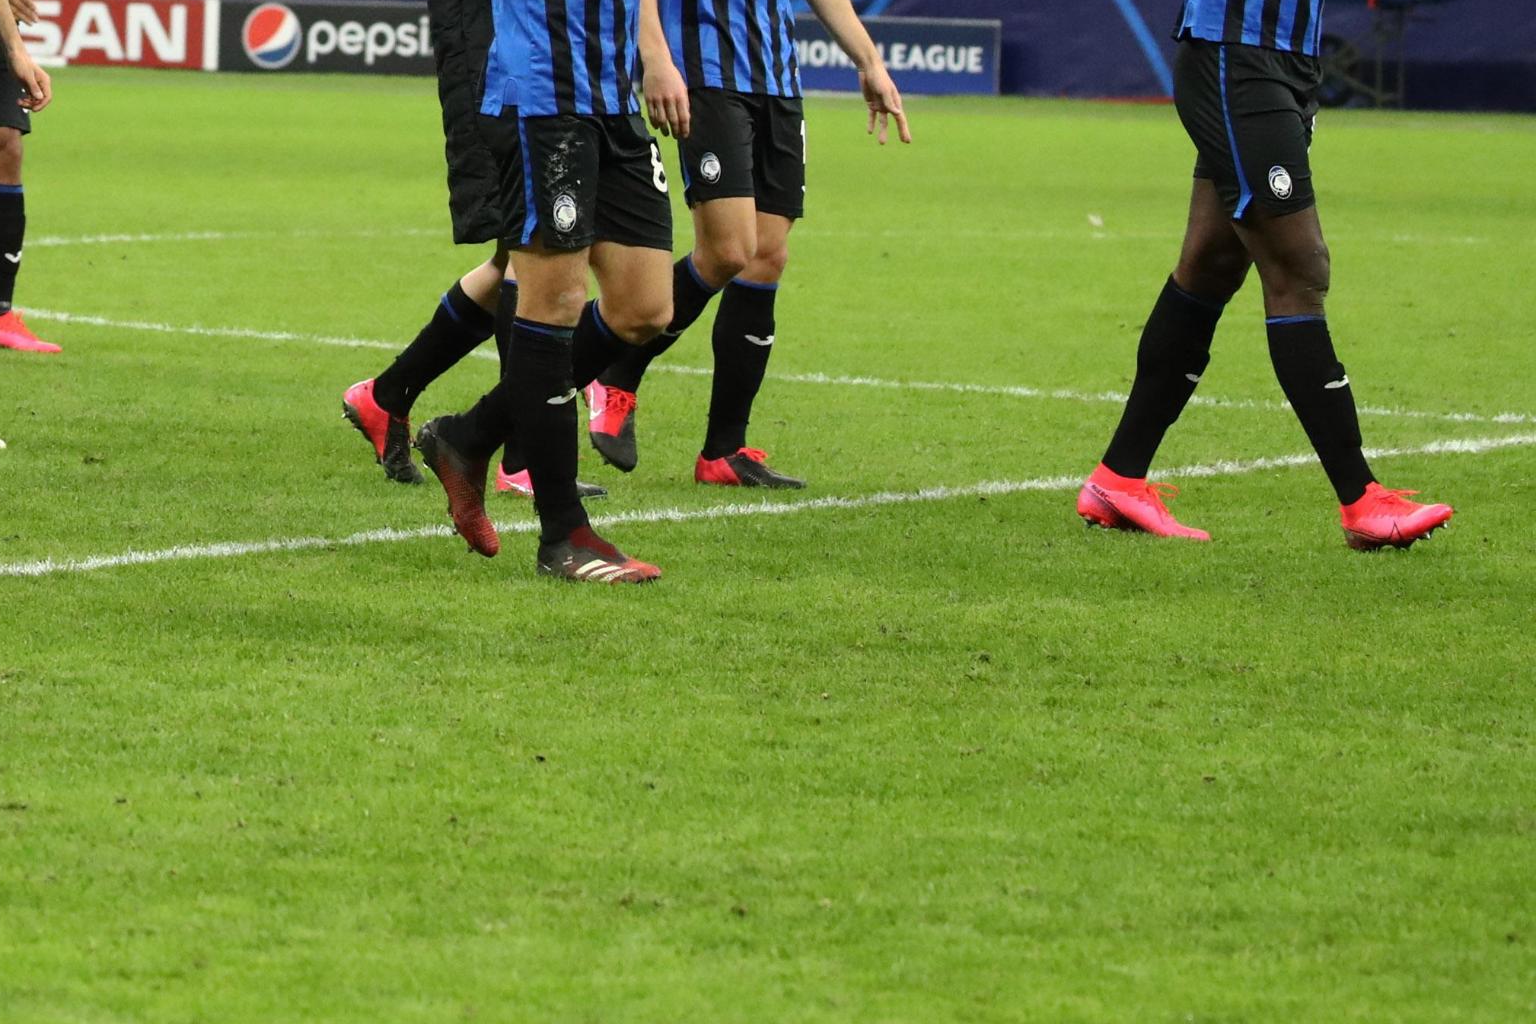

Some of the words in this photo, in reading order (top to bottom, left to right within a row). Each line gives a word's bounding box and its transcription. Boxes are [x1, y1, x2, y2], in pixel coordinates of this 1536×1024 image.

[18, 0, 187, 62] SAN
[307, 15, 432, 65] pepsi
[880, 42, 983, 74] LEAGUE
